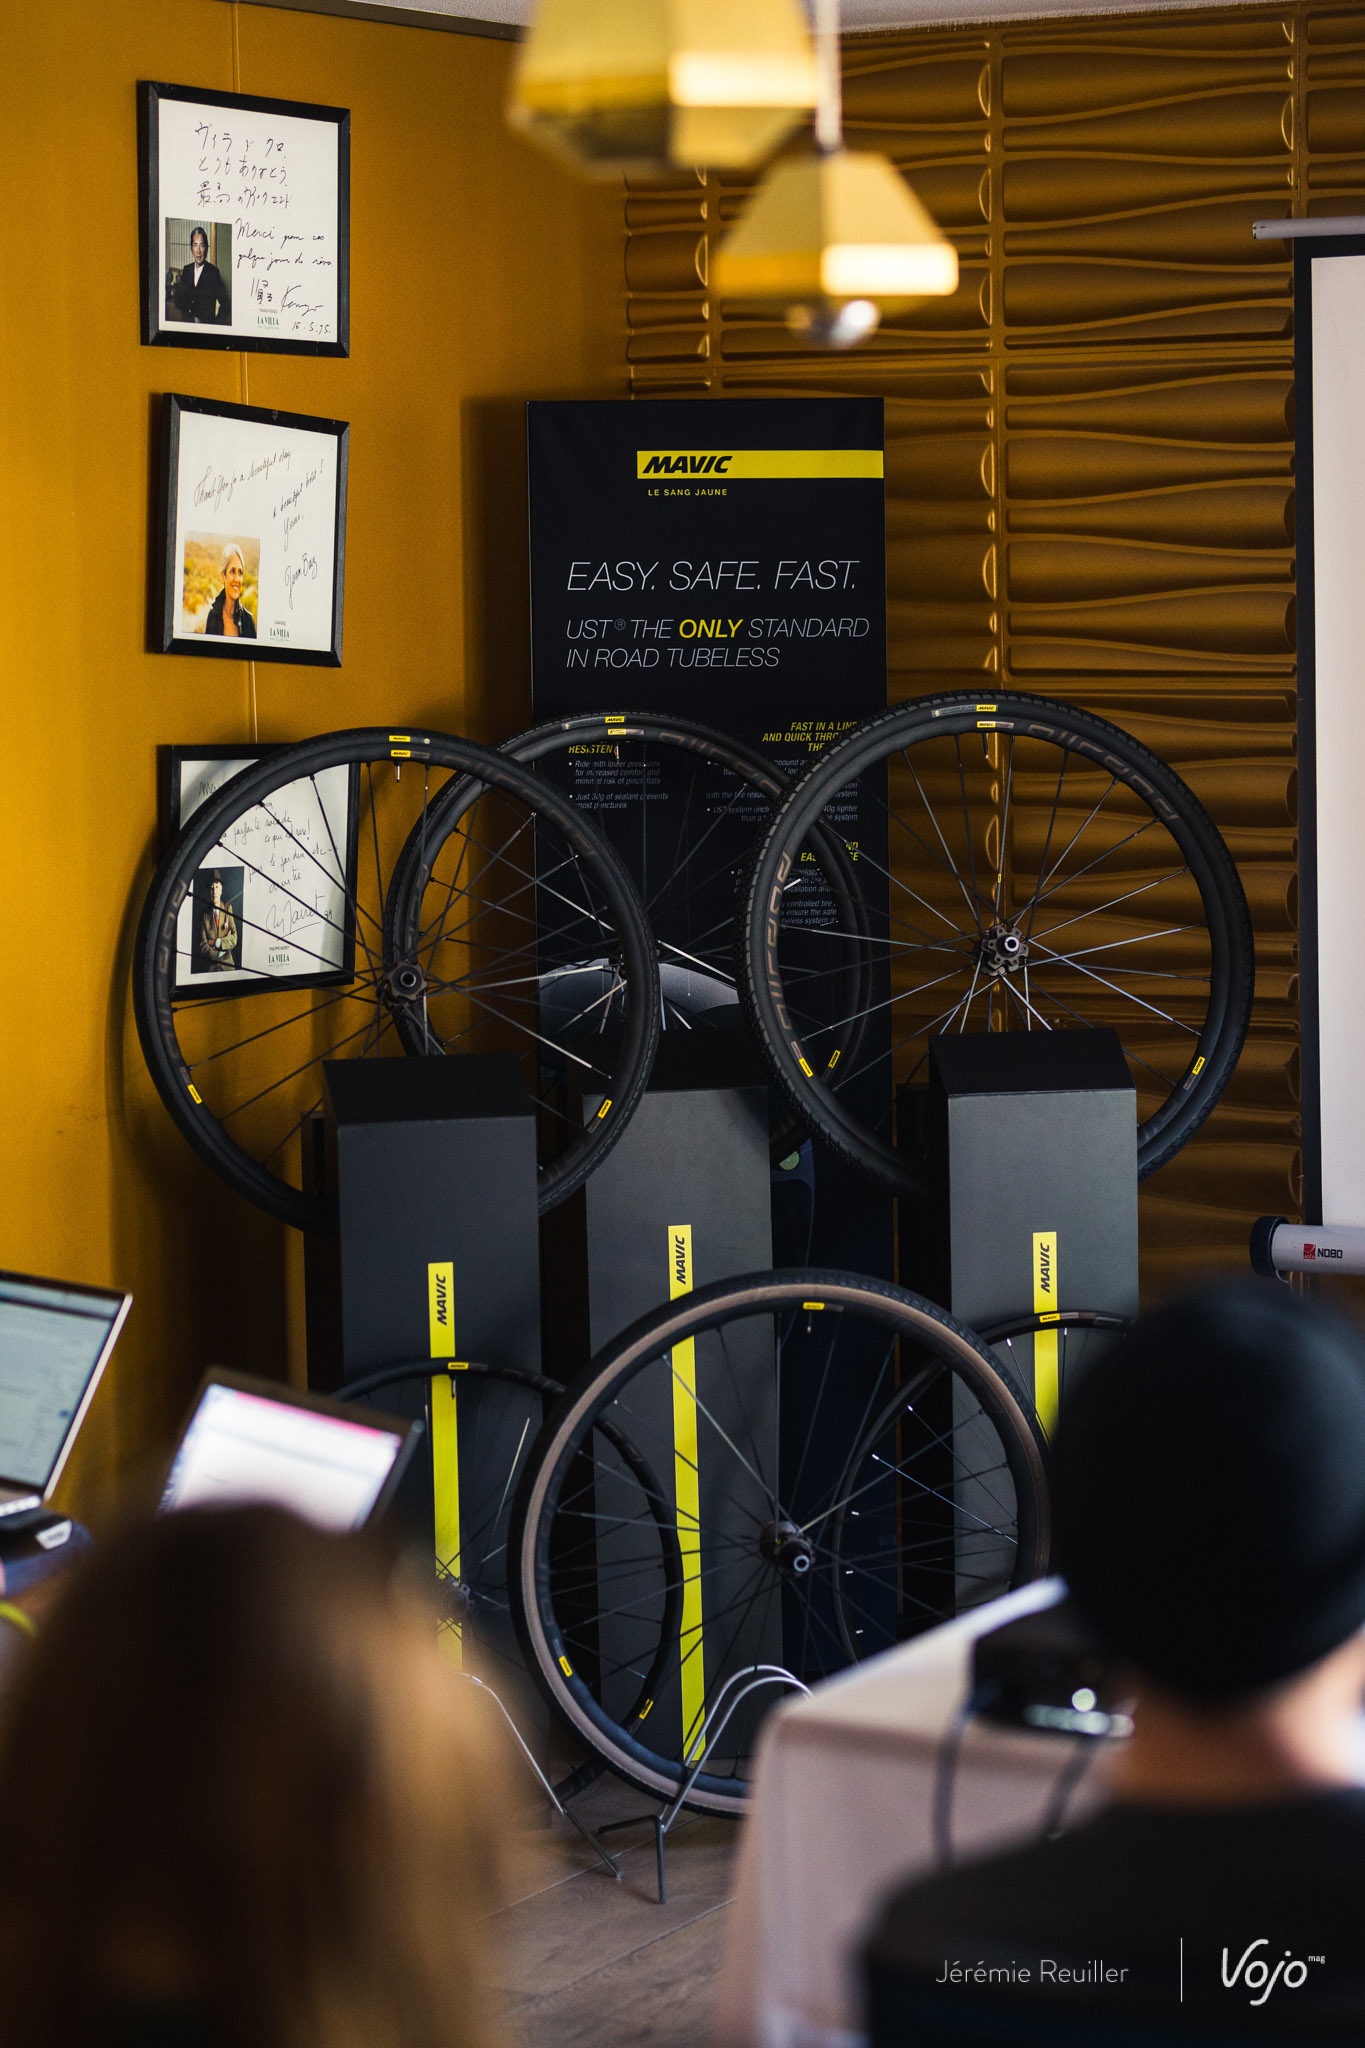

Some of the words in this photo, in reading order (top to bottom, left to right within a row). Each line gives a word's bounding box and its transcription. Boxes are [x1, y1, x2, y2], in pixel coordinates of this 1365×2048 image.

[235, 217, 275, 241] Merci
[643, 456, 732, 474] MAVIC
[648, 489, 661, 497] LE
[664, 489, 691, 497] SANG
[695, 489, 727, 497] JAUNE
[567, 561, 659, 591] EASY.
[669, 561, 760, 590] SAFE.
[774, 560, 860, 590] FAST.
[631, 619, 674, 639] THE
[679, 619, 743, 639] ONLY
[748, 619, 869, 638] STANDARD
[566, 649, 588, 668] IN
[594, 649, 659, 668] ROAD
[668, 648, 780, 668] TUBELESS
[791, 721, 813, 731] FAST
[814, 721, 825, 731] IN
[827, 721, 836, 731] A
[762, 733, 782, 742] AND
[784, 733, 812, 743] QUICK
[675, 1235, 686, 1285] MAVIC
[1317, 1248, 1343, 1259] NOBO
[1040, 1242, 1050, 1294] MAVIC
[436, 1273, 447, 1326] MAVIC
